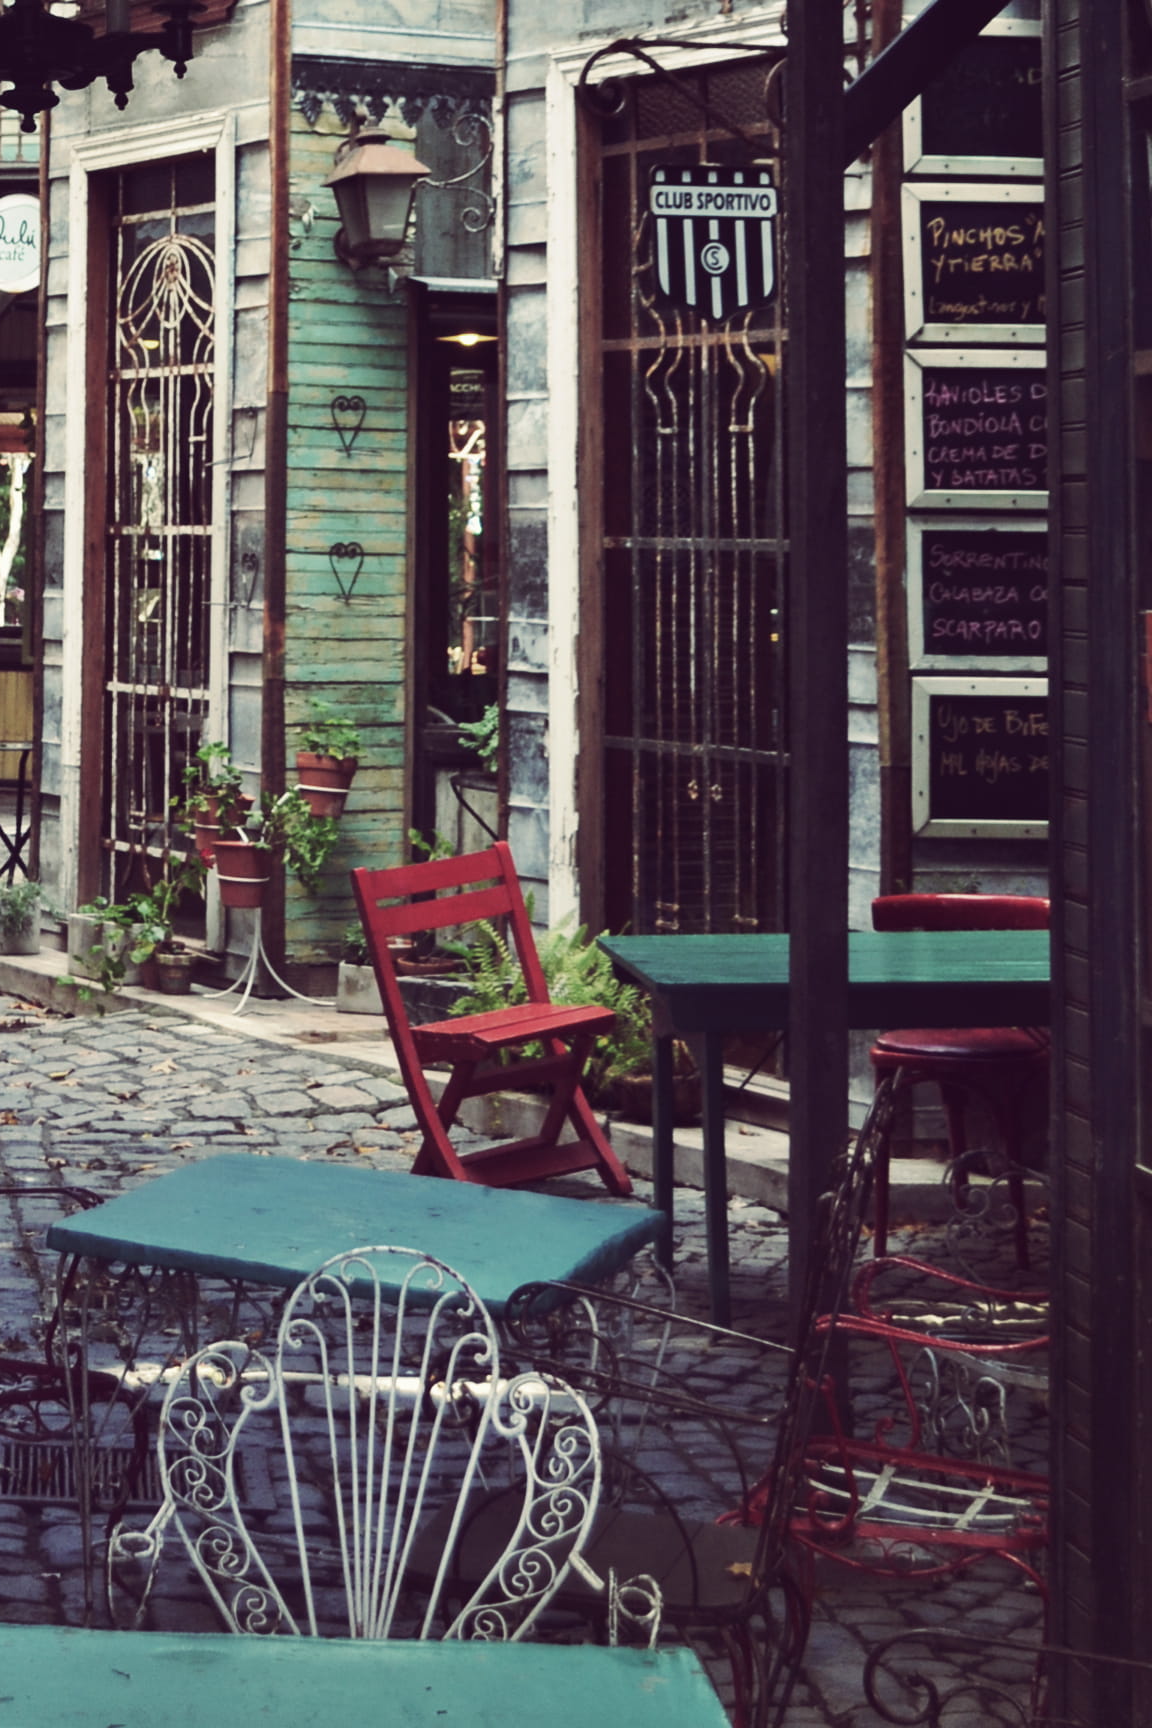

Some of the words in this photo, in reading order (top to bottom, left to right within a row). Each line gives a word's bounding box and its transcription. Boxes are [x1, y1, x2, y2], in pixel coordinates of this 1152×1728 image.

[655, 191, 693, 210] CLUB
[697, 192, 771, 211] SPORTIVO
[927, 217, 1025, 250] PINCHOS
[992, 443, 1021, 460] DE
[931, 469, 945, 487] Y
[951, 468, 1038, 487] BATATAS
[929, 581, 1019, 604] CALABAZA
[971, 715, 998, 735] DE
